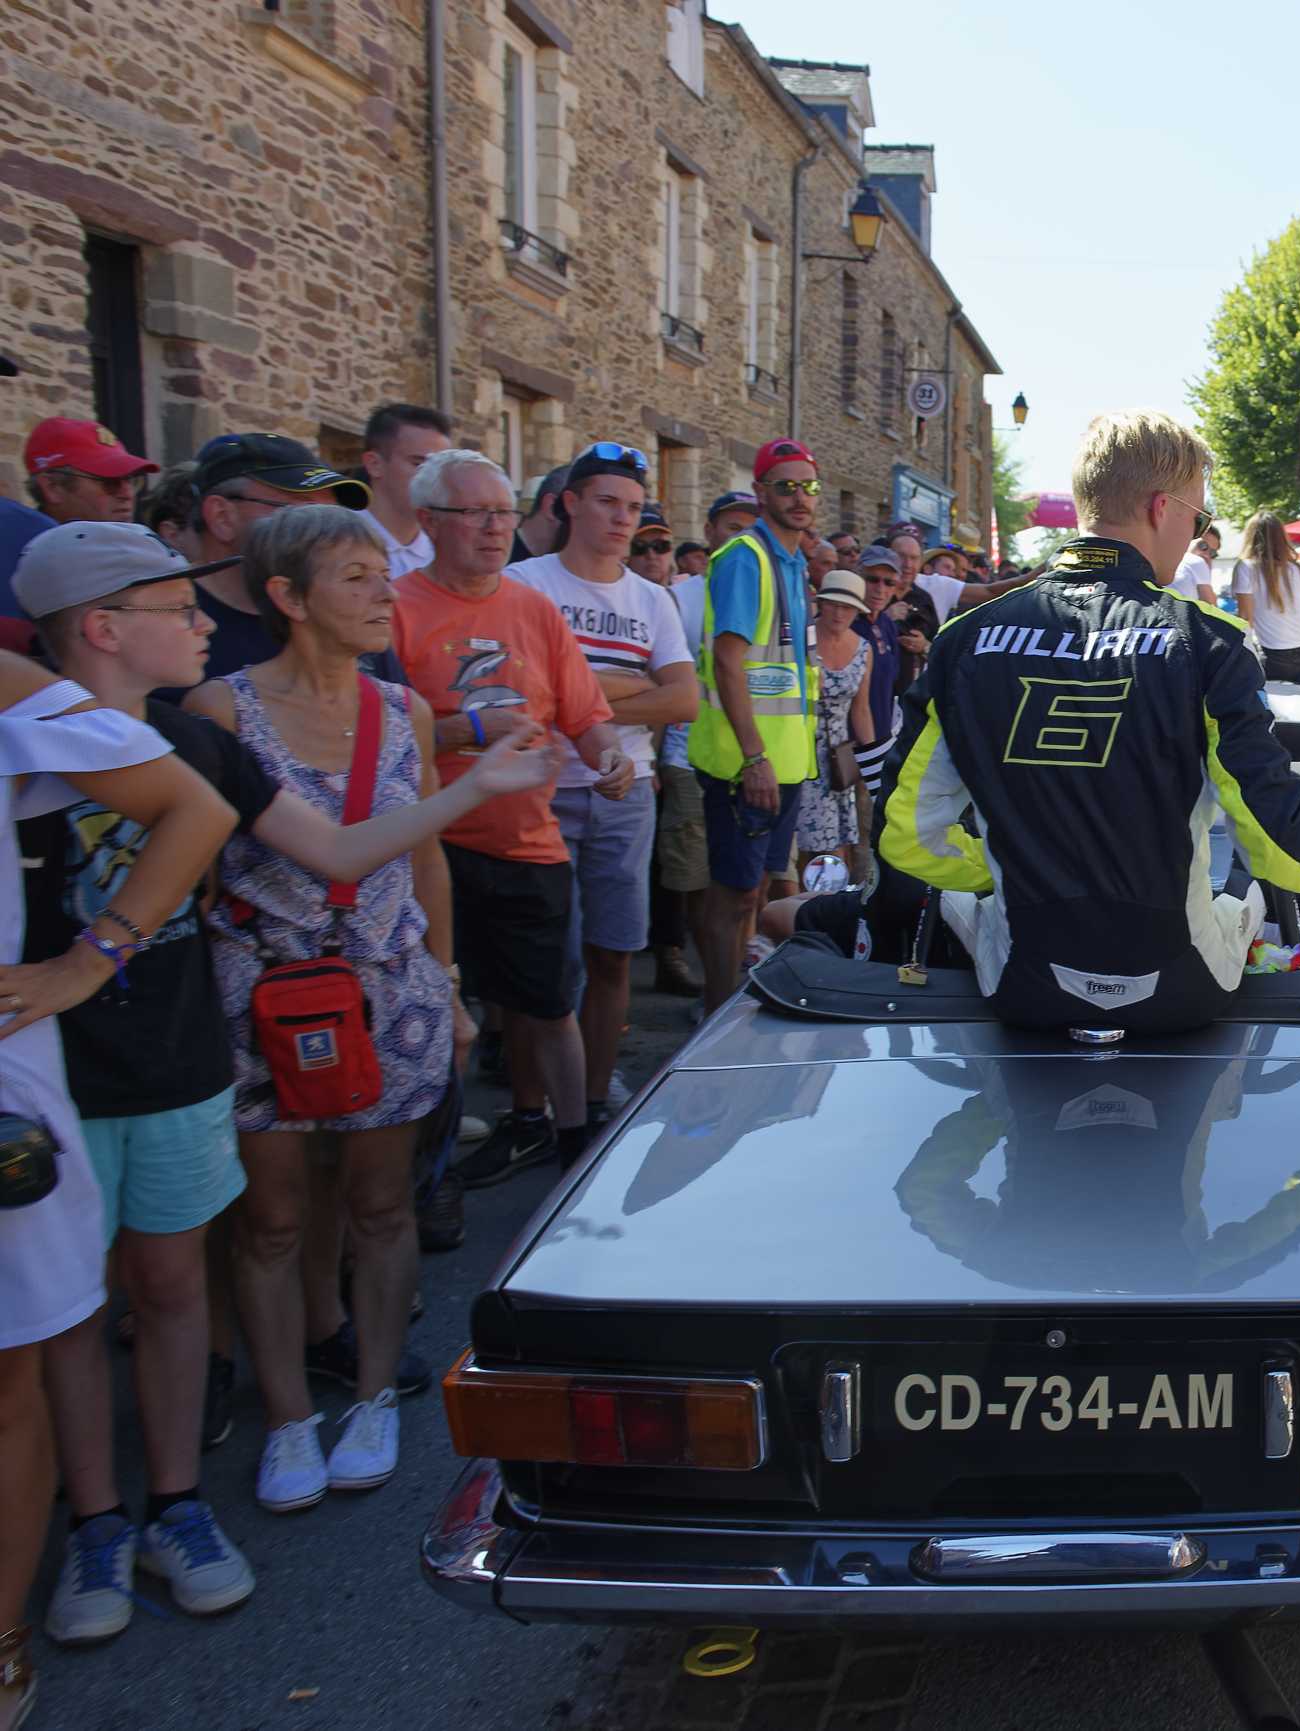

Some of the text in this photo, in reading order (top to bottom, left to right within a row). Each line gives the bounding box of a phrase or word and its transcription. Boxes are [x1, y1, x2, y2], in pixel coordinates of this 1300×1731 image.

[973, 624, 1176, 662] WILLIAM
[1003, 676, 1134, 768] 6
[1085, 980, 1126, 996] freem
[894, 1373, 1234, 1432] CD-734-AM
